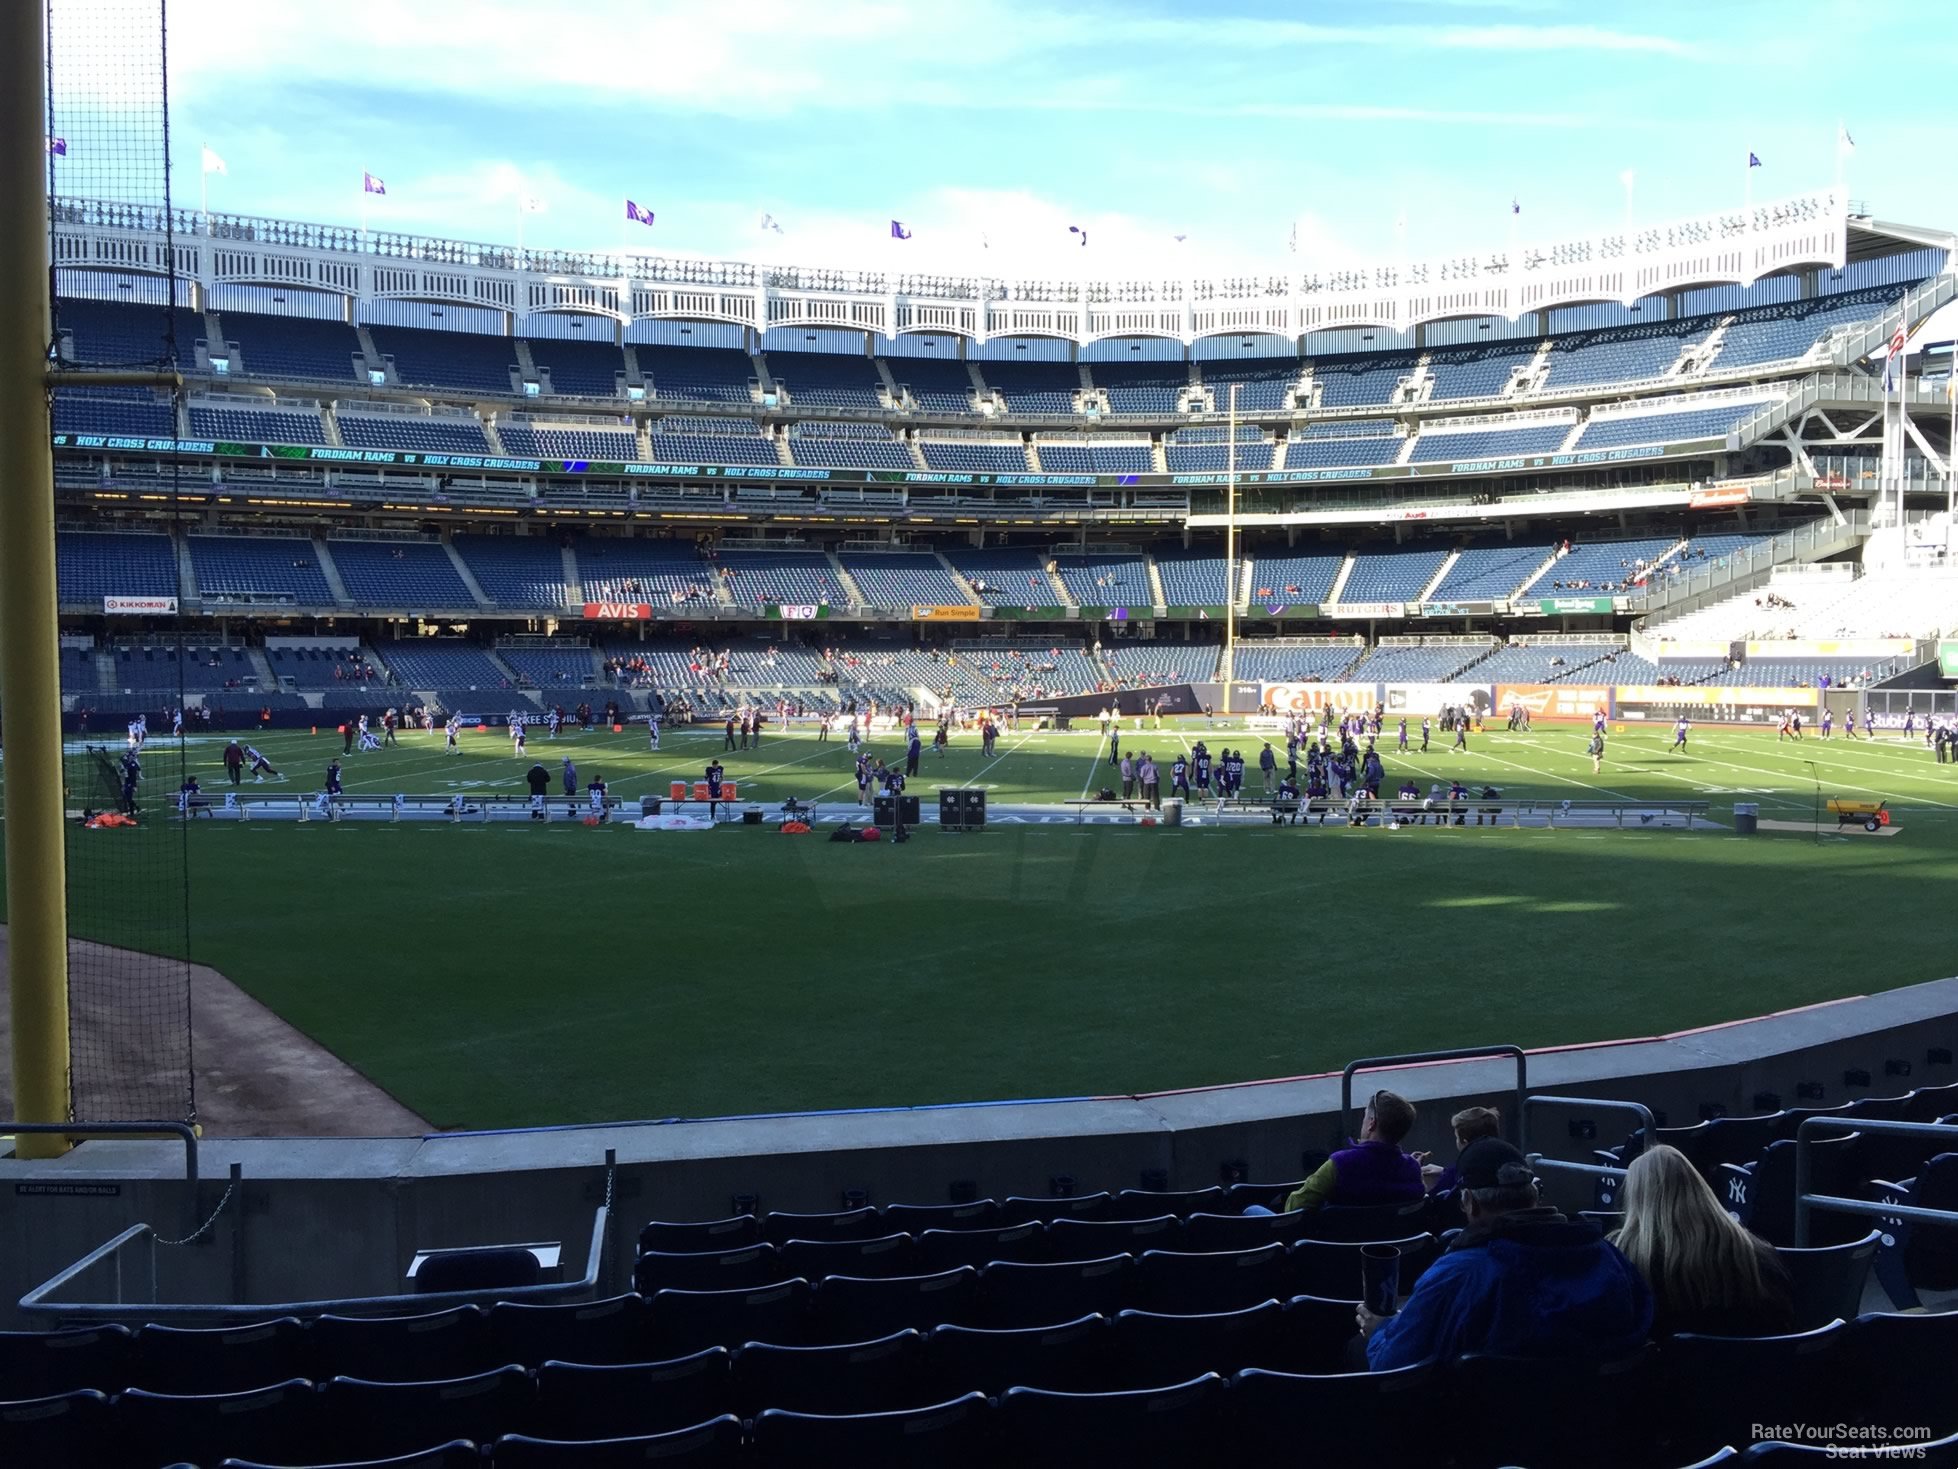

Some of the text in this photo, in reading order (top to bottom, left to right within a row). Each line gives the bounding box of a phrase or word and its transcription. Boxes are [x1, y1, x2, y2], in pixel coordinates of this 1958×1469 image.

[76, 435, 105, 447] HOLY
[107, 438, 145, 449] CROSS
[310, 448, 363, 461] FORDHAM
[363, 451, 395, 462] RAMS
[423, 455, 450, 465] HOLY
[450, 456, 482, 467] CROSS
[484, 458, 540, 470] CRUSADERS
[1452, 462, 1496, 472] FORDHAM
[1497, 459, 1525, 469] RAMS
[1552, 455, 1576, 465] HOLY
[1577, 453, 1606, 463] CROSS
[1608, 447, 1664, 461] CRUSADERS
[624, 464, 671, 474] FORDHAM
[671, 465, 698, 475] RAMS
[724, 468, 747, 477] HOLY
[747, 468, 777, 477] CROSS
[778, 469, 830, 479] CRUSADERS
[1172, 475, 1215, 484] FORDHAM
[1266, 473, 1290, 482] HOLY
[1290, 471, 1319, 481] CROSS
[1319, 469, 1372, 480] CRUSADERS
[905, 473, 947, 482] FORDHAM
[947, 474, 973, 483] RAMS
[995, 475, 1017, 484] HOLY
[1017, 475, 1046, 484] CROSS
[1047, 476, 1096, 485] CRUSADERS
[119, 601, 166, 609] KIKKOMAN
[597, 604, 639, 618] AVIS
[1337, 604, 1398, 613] RUTGERS
[918, 609, 976, 618] SAP Run Simple
[1264, 686, 1375, 711] Canon
[1174, 763, 1185, 774] 27
[1198, 758, 1209, 769] 40
